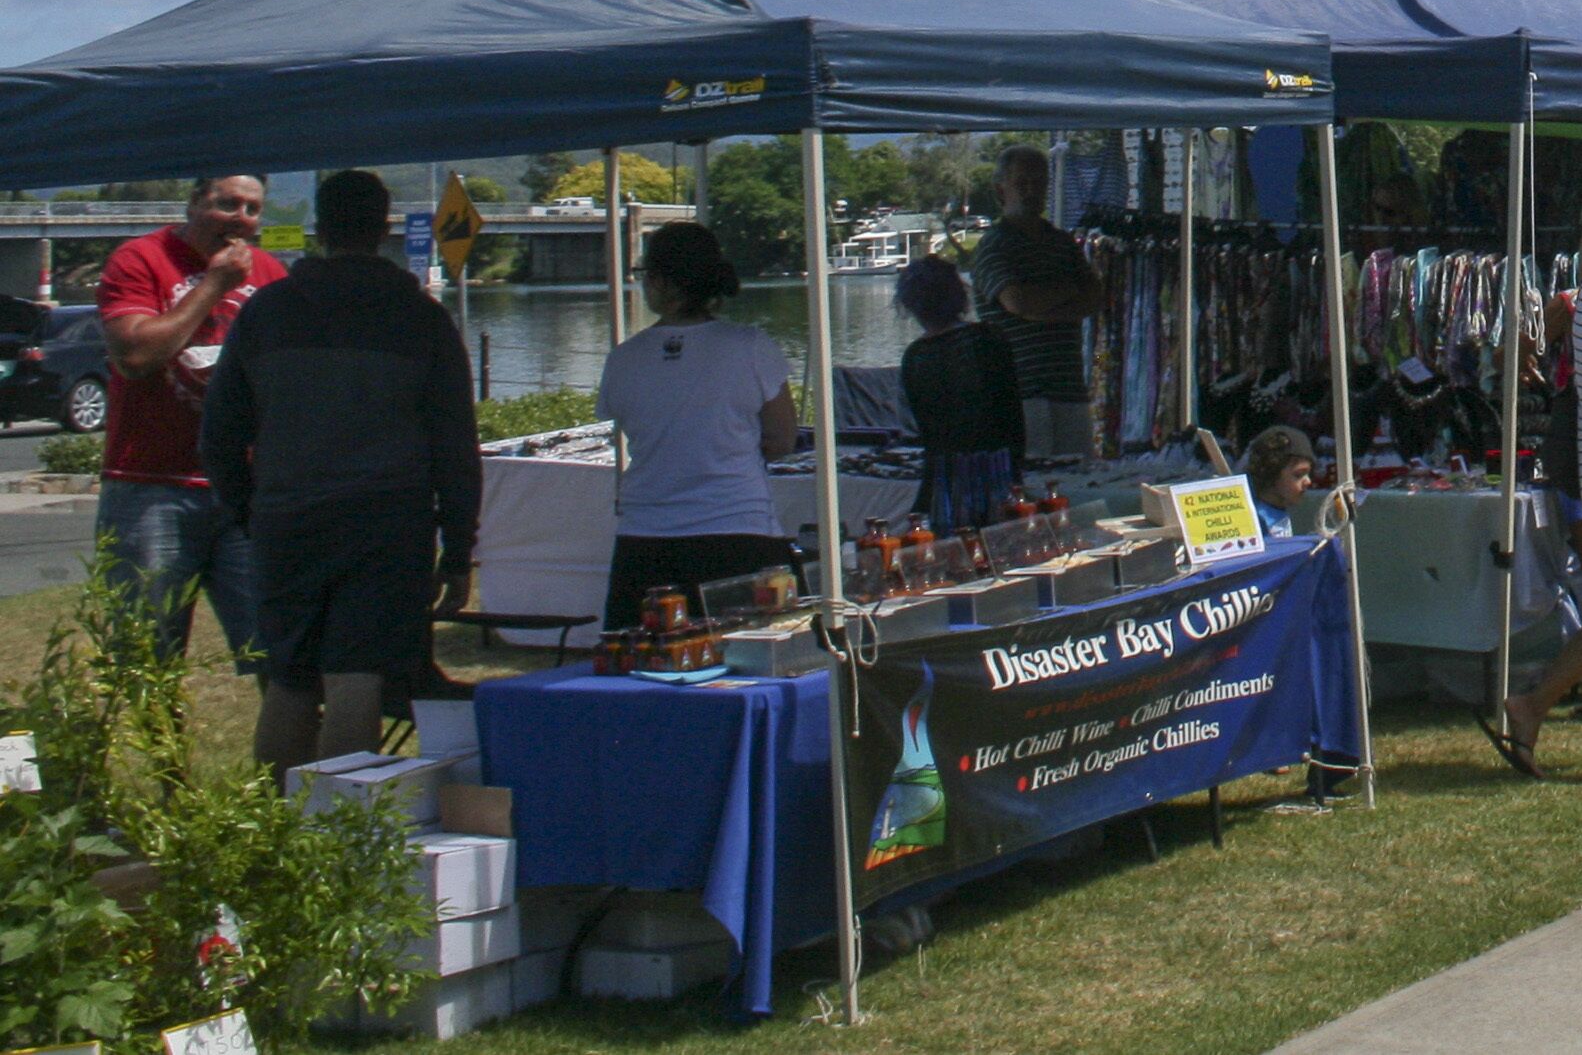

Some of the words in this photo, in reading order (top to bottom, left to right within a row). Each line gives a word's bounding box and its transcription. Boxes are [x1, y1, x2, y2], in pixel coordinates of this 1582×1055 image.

[1198, 490, 1239, 503] NATIONAL
[1192, 502, 1245, 517] INTERNATIONAL
[1205, 515, 1232, 528] CHILLI
[1205, 527, 1241, 541] AWARDS
[982, 635, 1108, 690] Disaster
[1116, 618, 1174, 658] Bay
[974, 743, 1010, 772] Hot
[1013, 728, 1067, 759] Chilli
[1071, 720, 1114, 744] Wine
[1130, 694, 1173, 727] Chilli
[1174, 672, 1275, 711] Condiments
[1031, 757, 1080, 791] Fresh
[1084, 736, 1149, 772] Organic
[1153, 720, 1220, 751] Chillies
